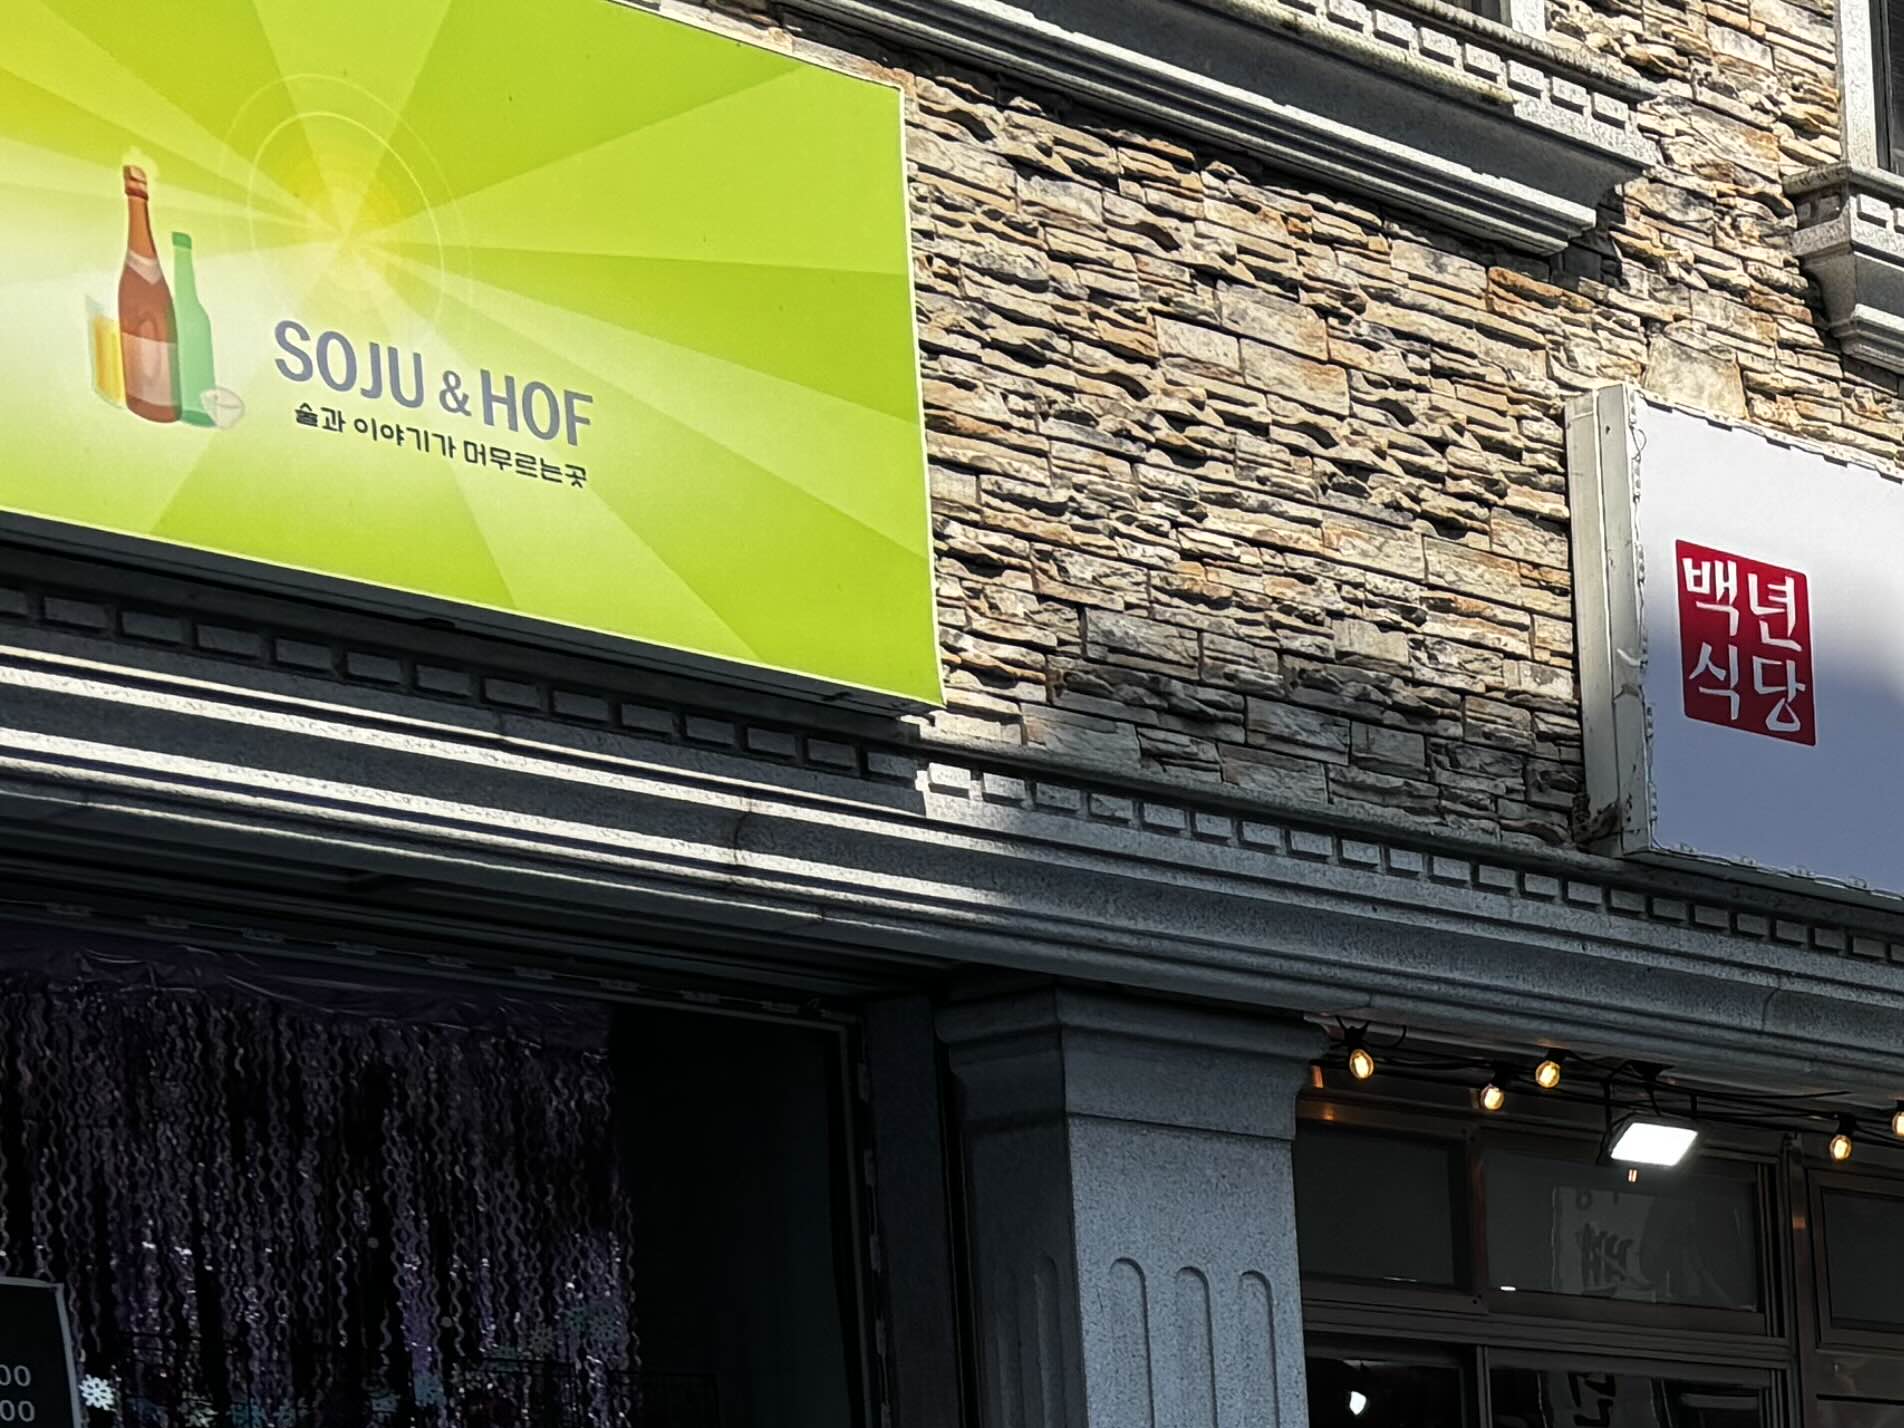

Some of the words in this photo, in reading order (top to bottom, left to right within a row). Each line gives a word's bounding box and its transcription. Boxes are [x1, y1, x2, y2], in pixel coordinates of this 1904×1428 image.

[274, 320, 424, 409] SOJU
[439, 370, 473, 417] &
[480, 368, 593, 447] HOF
[295, 402, 345, 433] 술과
[354, 417, 456, 459] 이야기가
[463, 439, 587, 489] 머무르는곳
[1682, 557, 1802, 652] 백년
[1689, 641, 1806, 733] 식당
